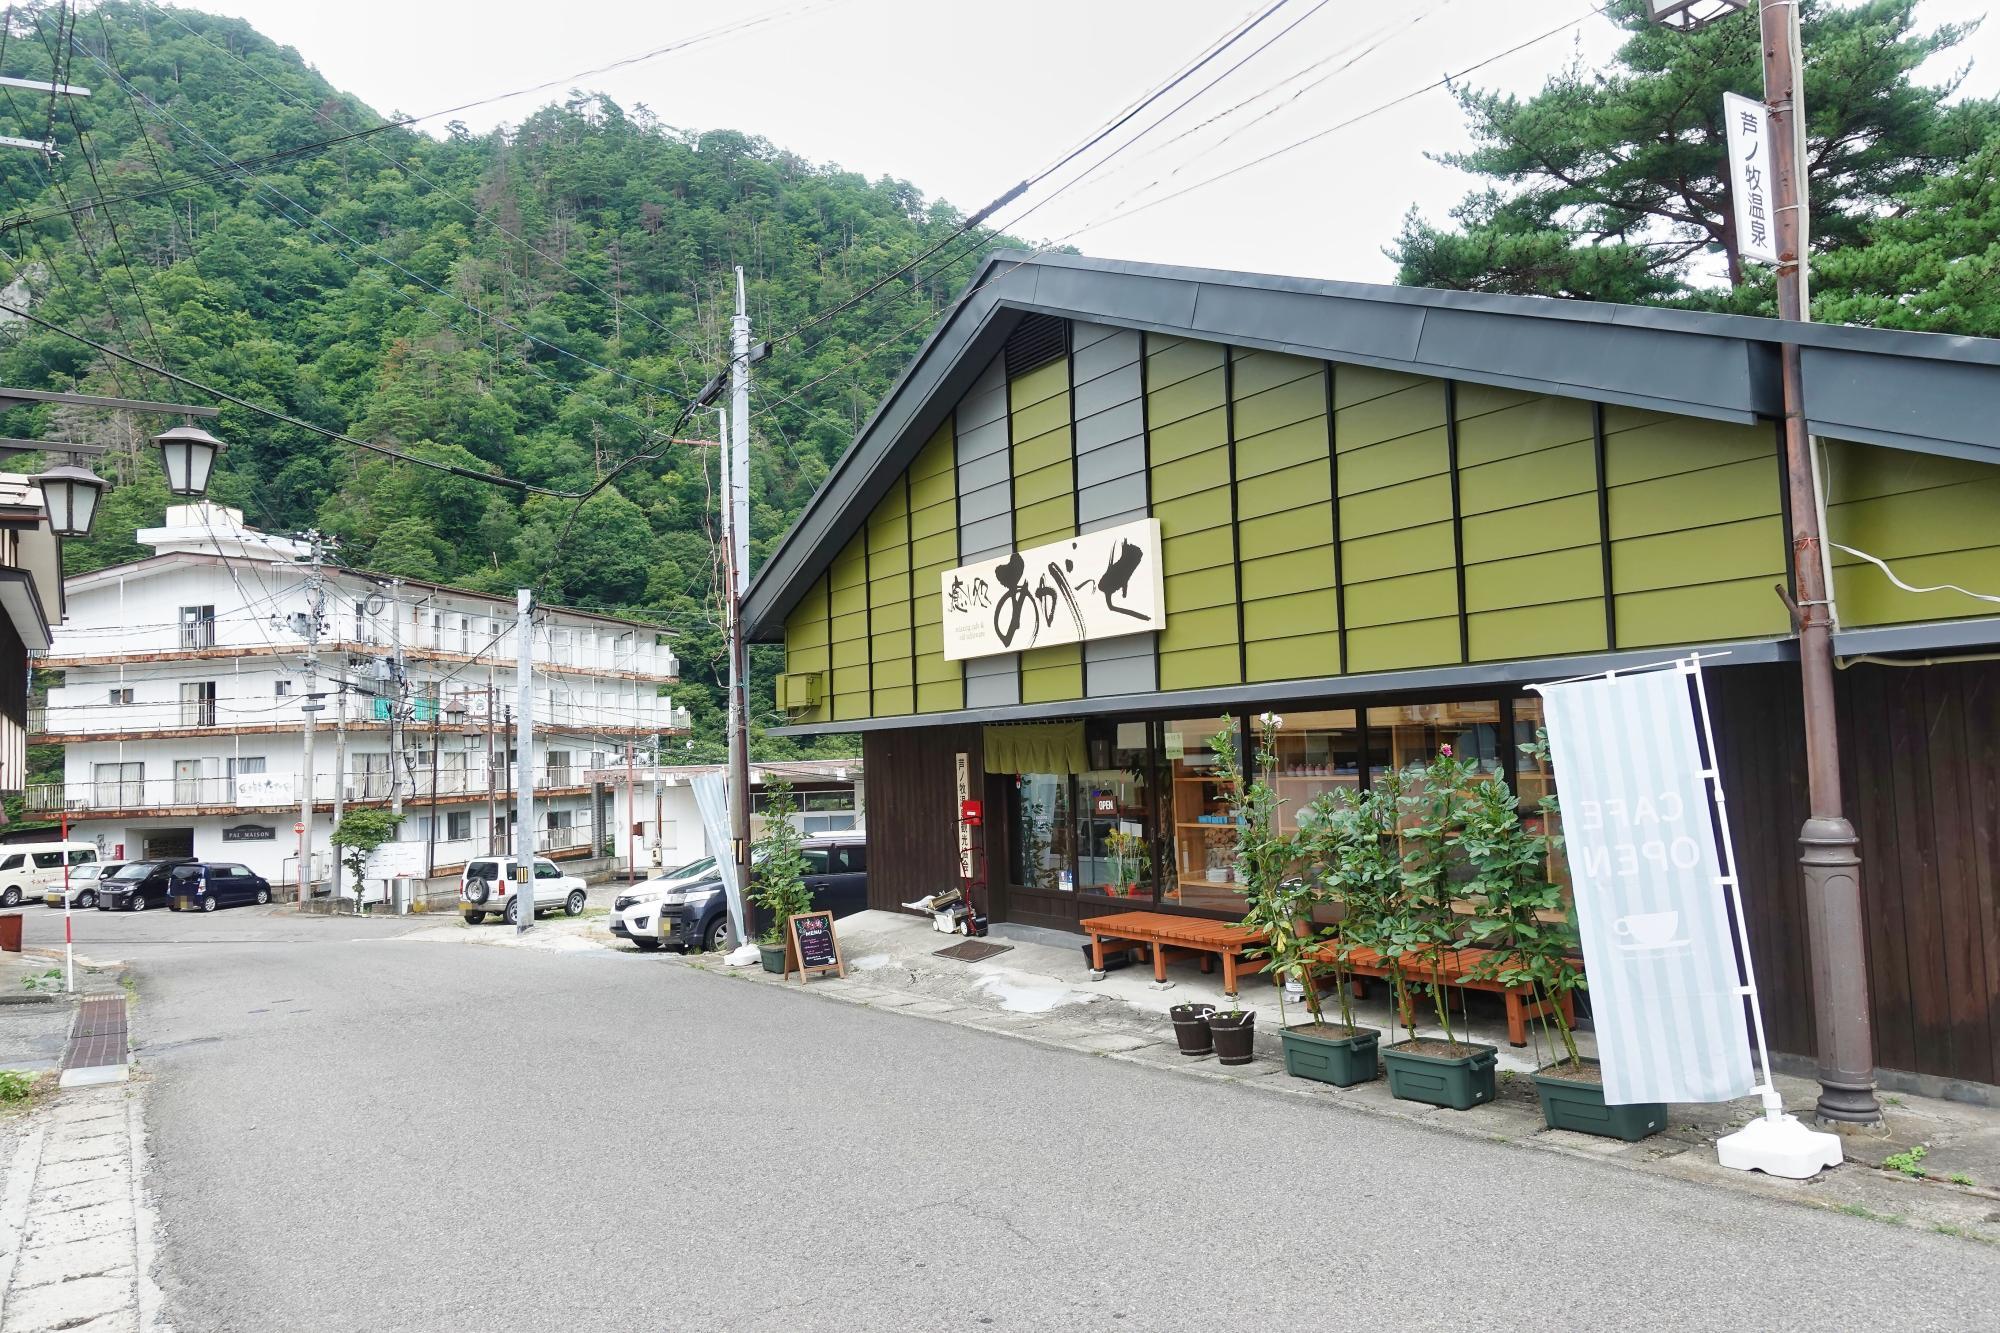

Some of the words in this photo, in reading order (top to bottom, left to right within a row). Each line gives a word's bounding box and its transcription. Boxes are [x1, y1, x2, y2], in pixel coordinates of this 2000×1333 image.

[1740, 111, 1768, 249] 芦ノ牧温泉
[1098, 800, 1114, 810] OPEN
